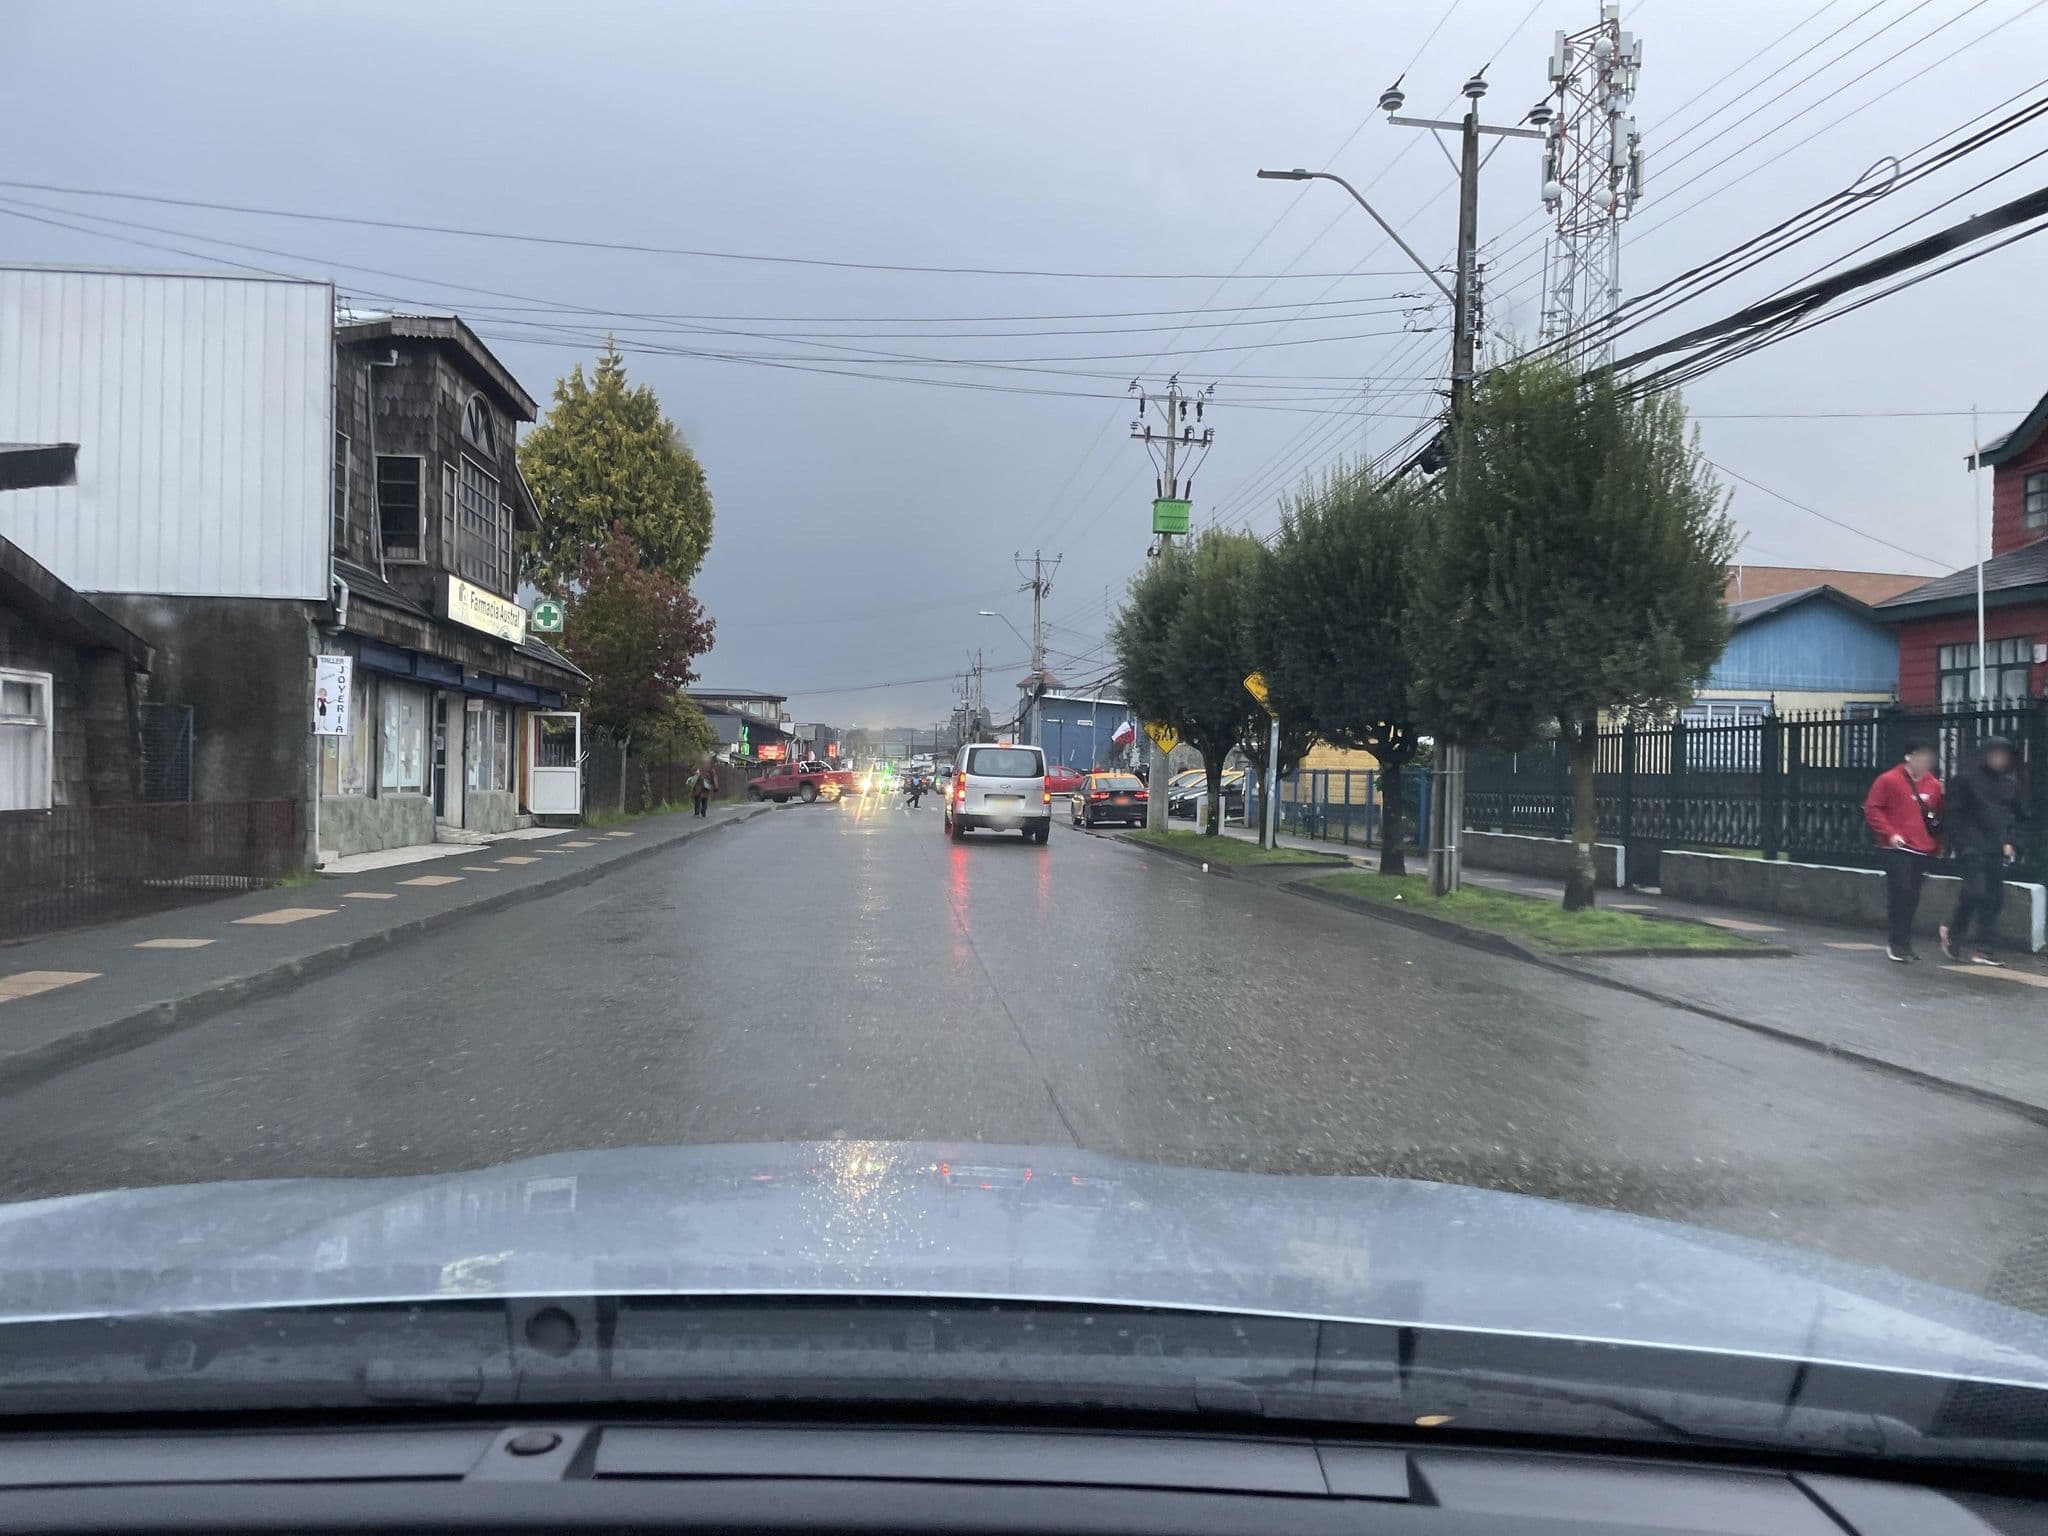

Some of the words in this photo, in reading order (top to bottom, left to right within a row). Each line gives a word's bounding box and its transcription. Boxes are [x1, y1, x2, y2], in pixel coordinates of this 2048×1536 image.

[470, 591, 499, 620] Farmacia
[500, 604, 520, 628] Austral
[320, 657, 345, 665] TALLER
